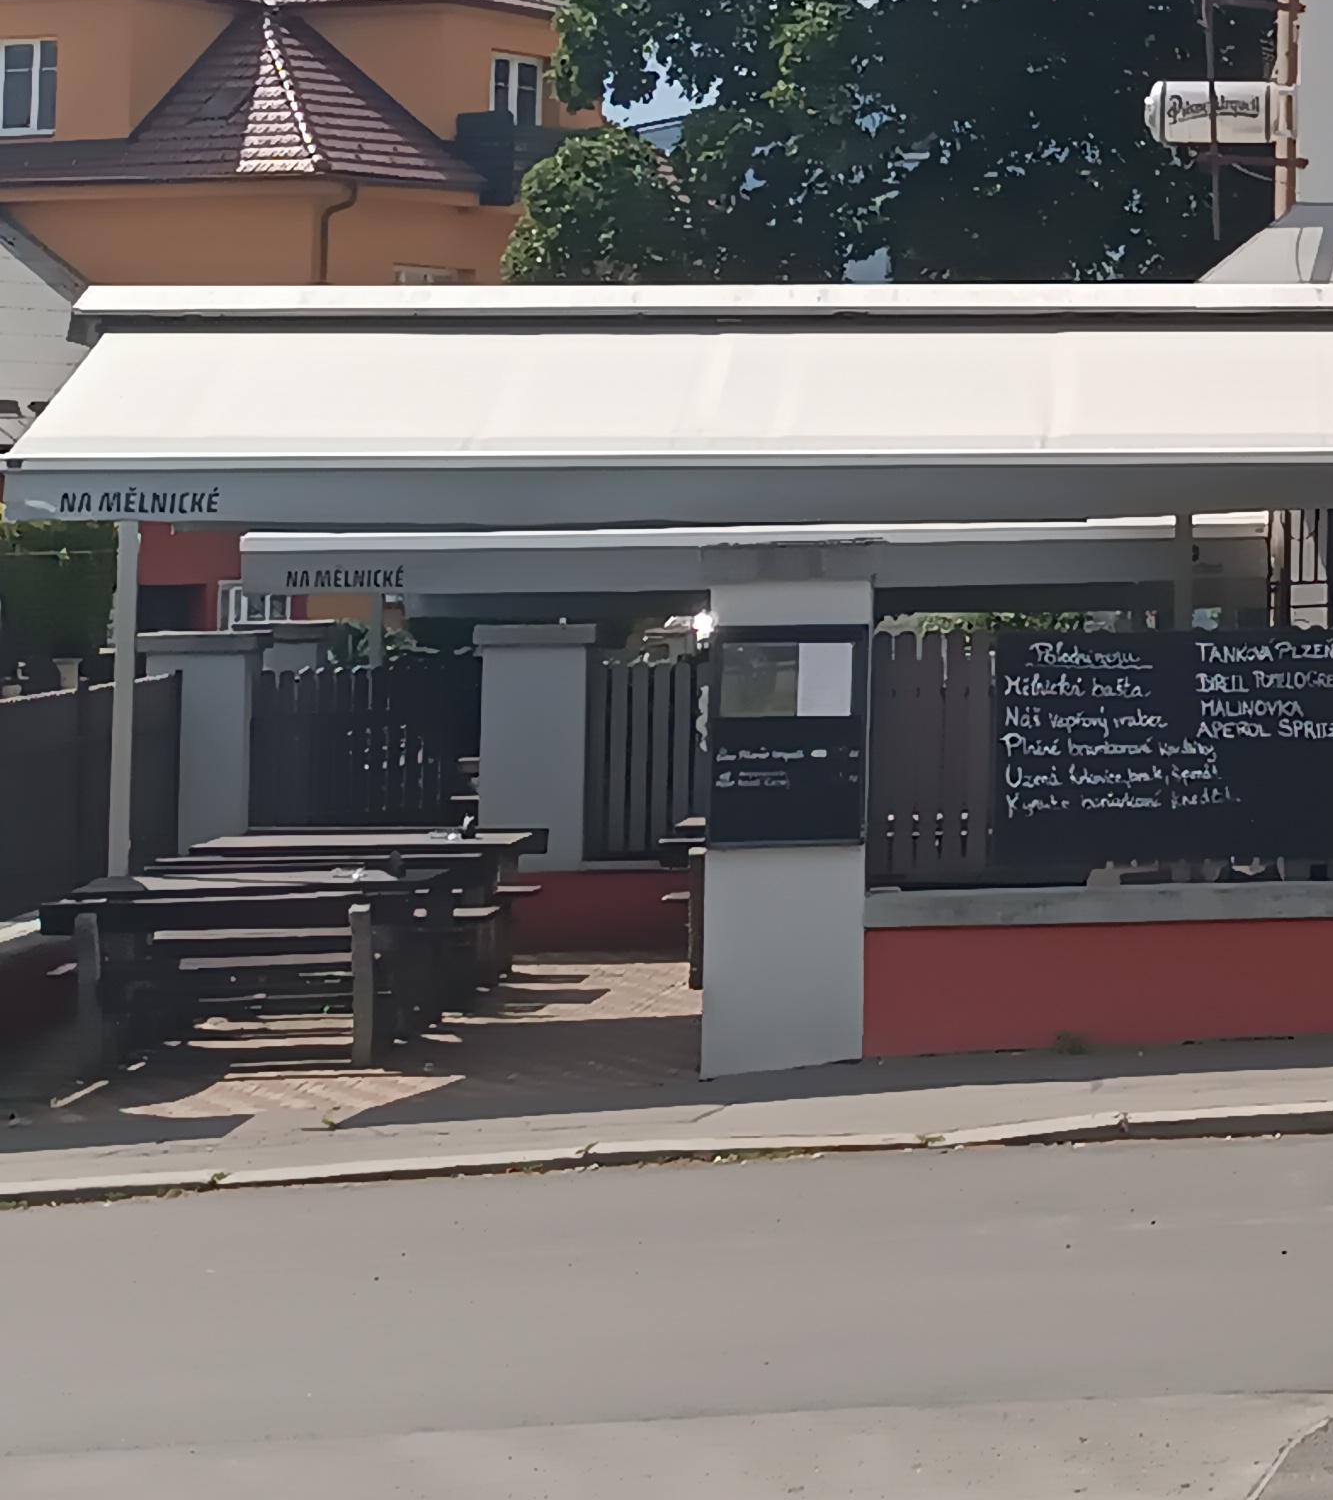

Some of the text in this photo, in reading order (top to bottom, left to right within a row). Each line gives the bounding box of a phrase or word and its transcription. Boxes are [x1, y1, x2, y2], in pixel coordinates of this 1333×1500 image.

[60, 487, 220, 513] NA MĚLNICKÉ
[286, 570, 309, 588] NA
[1200, 699, 1304, 718] MALINOVKA
